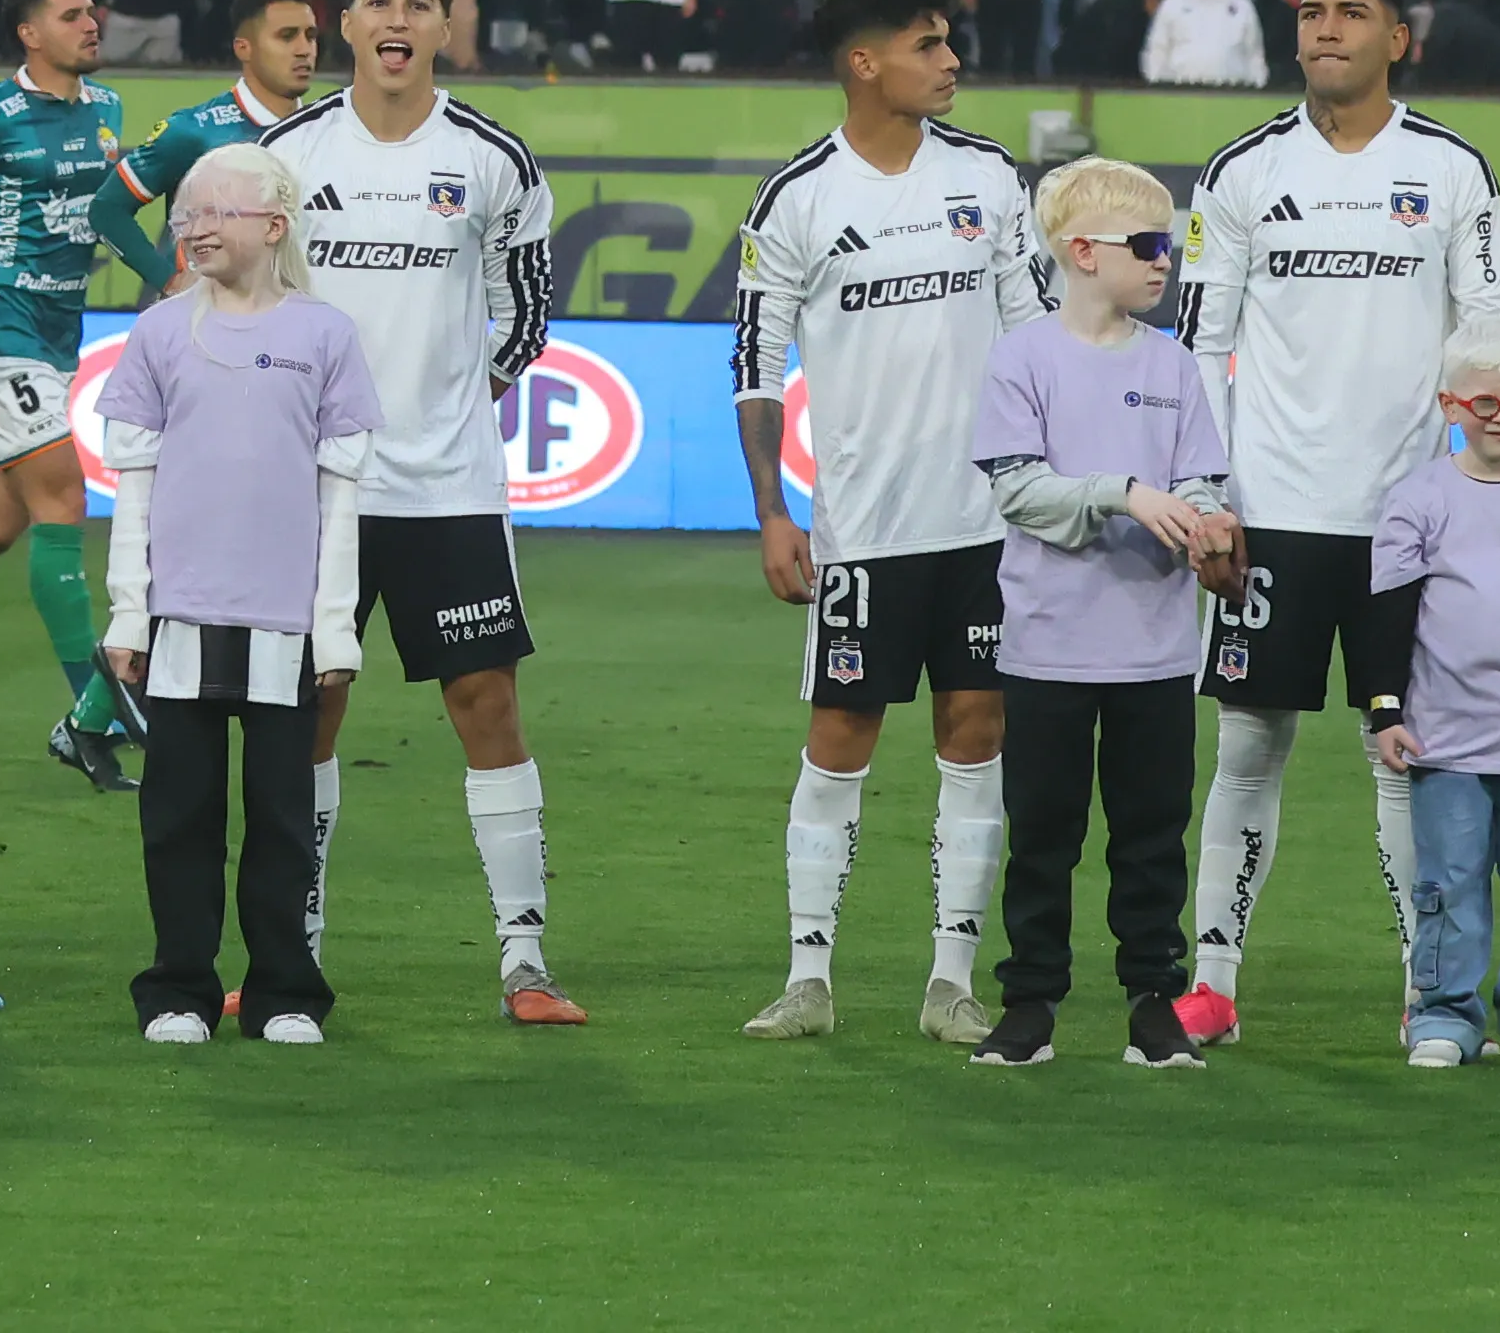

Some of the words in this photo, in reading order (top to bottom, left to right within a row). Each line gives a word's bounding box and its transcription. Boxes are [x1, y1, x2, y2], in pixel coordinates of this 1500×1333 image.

[211, 103, 242, 117] TEC
[349, 191, 422, 202] JETOUR
[1309, 201, 1384, 211] JETOUR
[872, 221, 943, 239] JETOUR
[8, 372, 41, 415] 5
[821, 564, 870, 630] 21
[436, 594, 513, 628] PHILIPS
[441, 629, 460, 645] TV
[463, 626, 475, 641] &
[477, 617, 516, 637] Audio
[969, 646, 988, 660] TV
